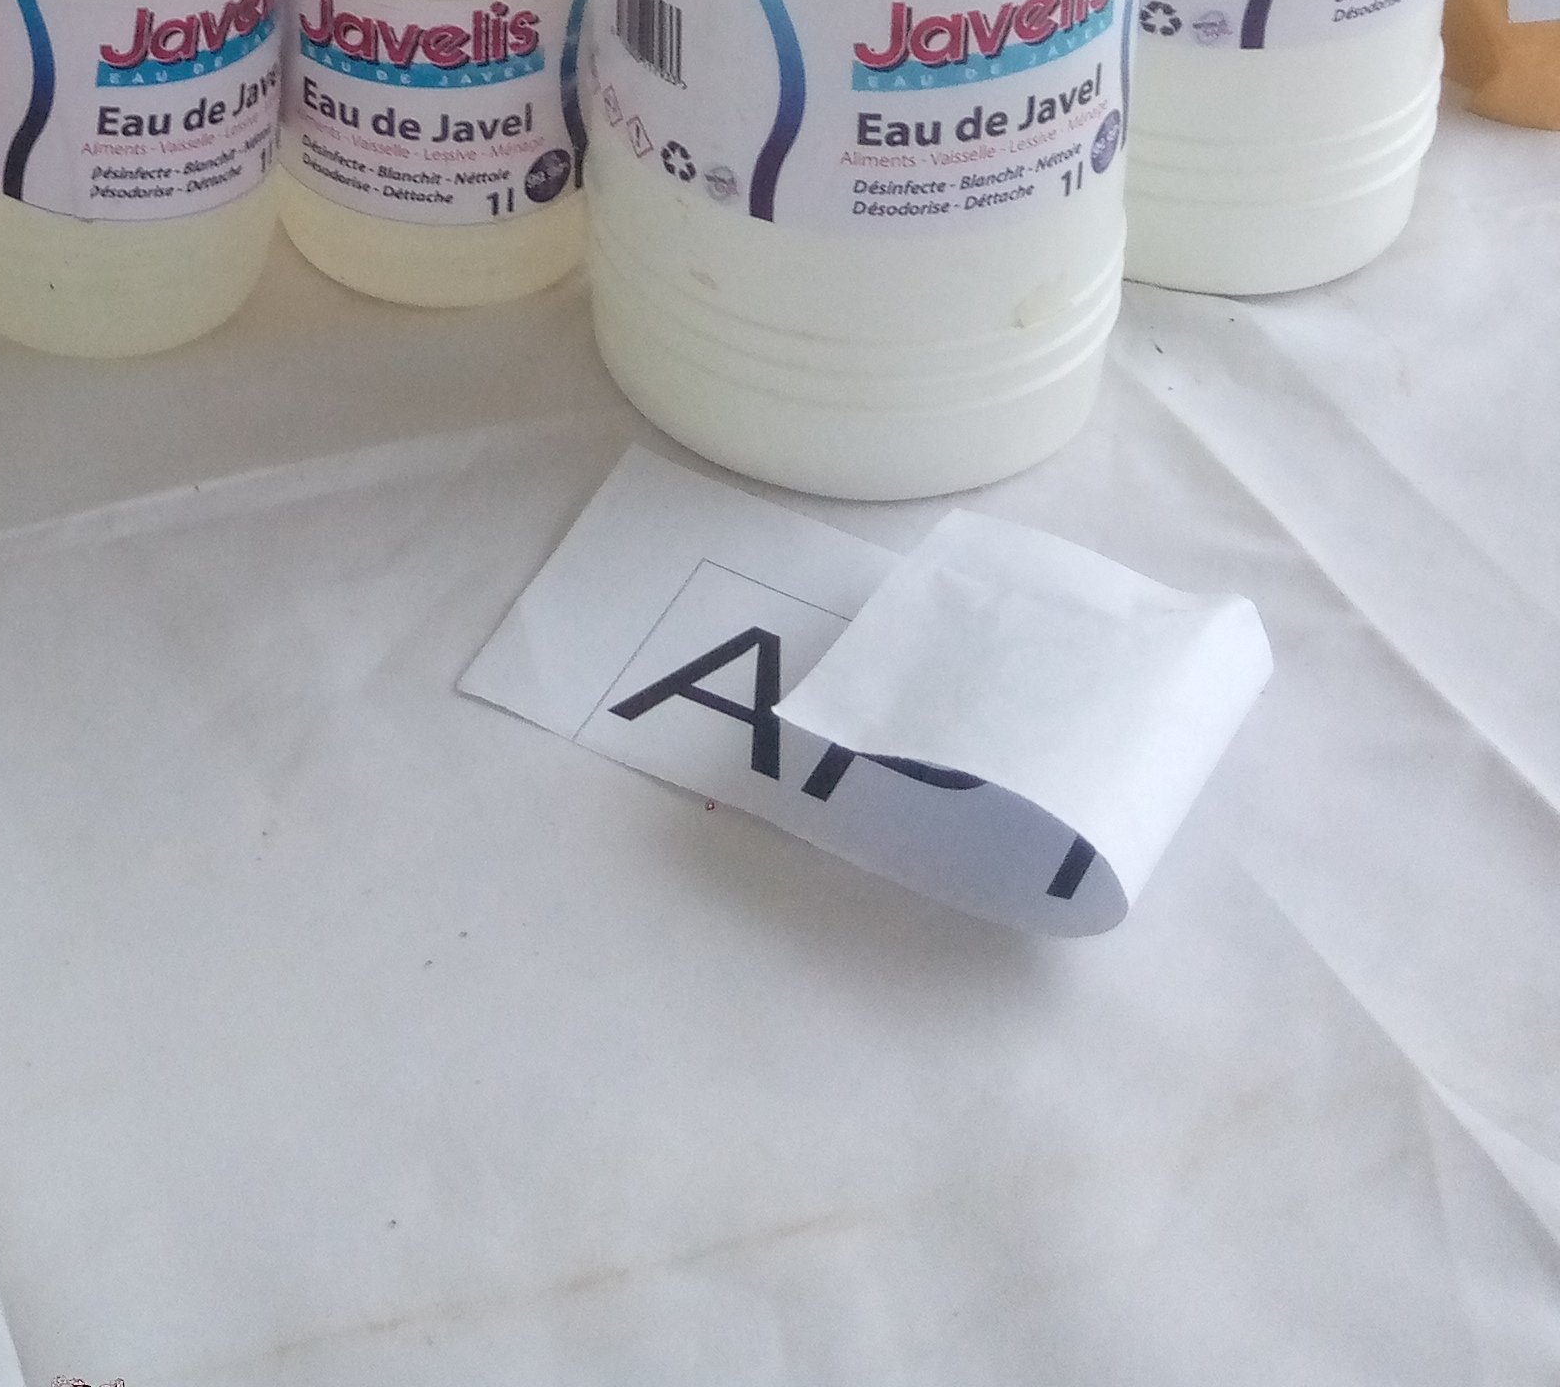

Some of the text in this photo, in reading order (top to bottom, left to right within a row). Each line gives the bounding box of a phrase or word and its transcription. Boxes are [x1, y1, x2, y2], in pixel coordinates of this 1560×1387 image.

[96, 105, 172, 138] Eau
[182, 96, 226, 131] de
[302, 76, 360, 129] Eau
[371, 107, 422, 142] de
[432, 101, 533, 143] Javel
[856, 62, 1102, 147] Eau de Javel
[840, 150, 916, 168] Aliments
[853, 178, 947, 195] Désinfecte
[959, 165, 1026, 190] Blanchit
[852, 198, 951, 216] Désodorise
